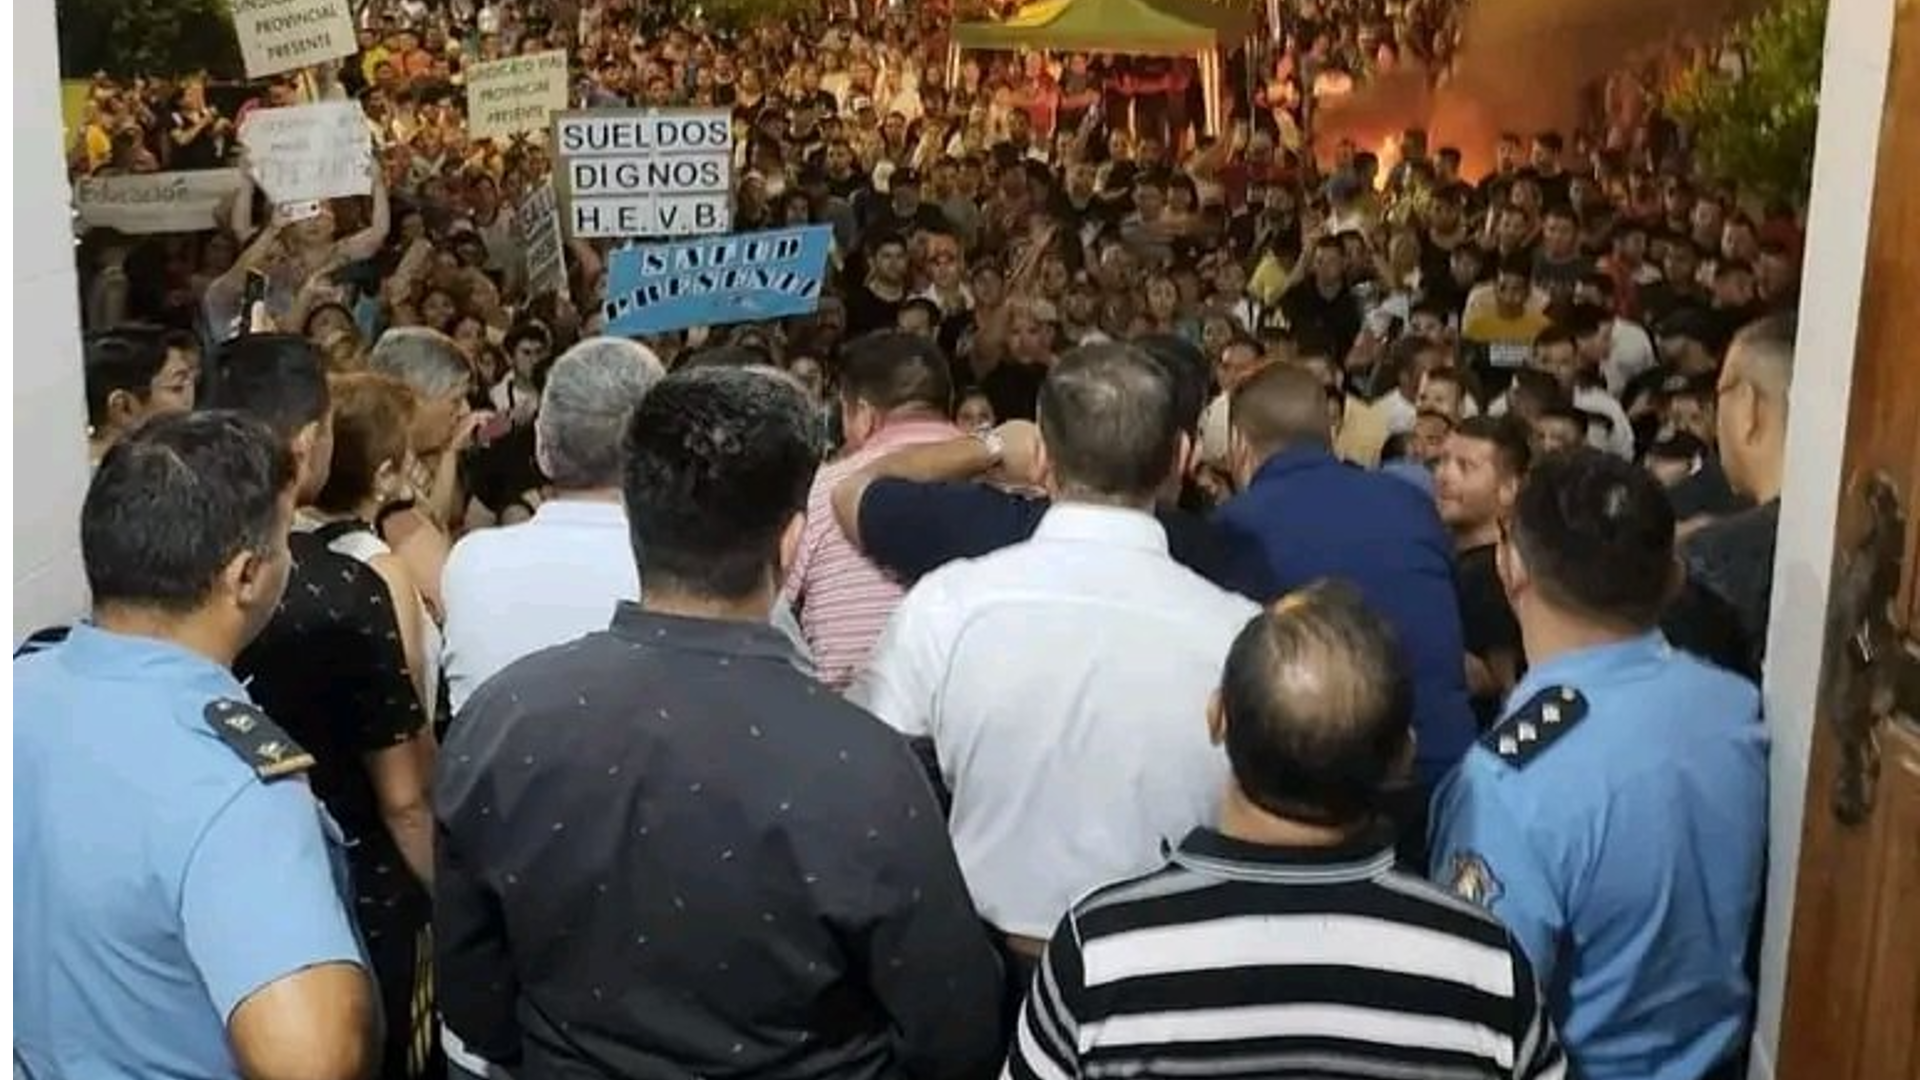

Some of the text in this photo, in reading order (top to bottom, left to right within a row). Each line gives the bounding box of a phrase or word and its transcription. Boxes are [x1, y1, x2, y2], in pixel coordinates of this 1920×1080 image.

[255, 2, 338, 33] PROVINCIAL
[267, 31, 332, 61] PRESENTE
[563, 121, 728, 150] SUELDOS
[641, 238, 801, 275] SALUD
